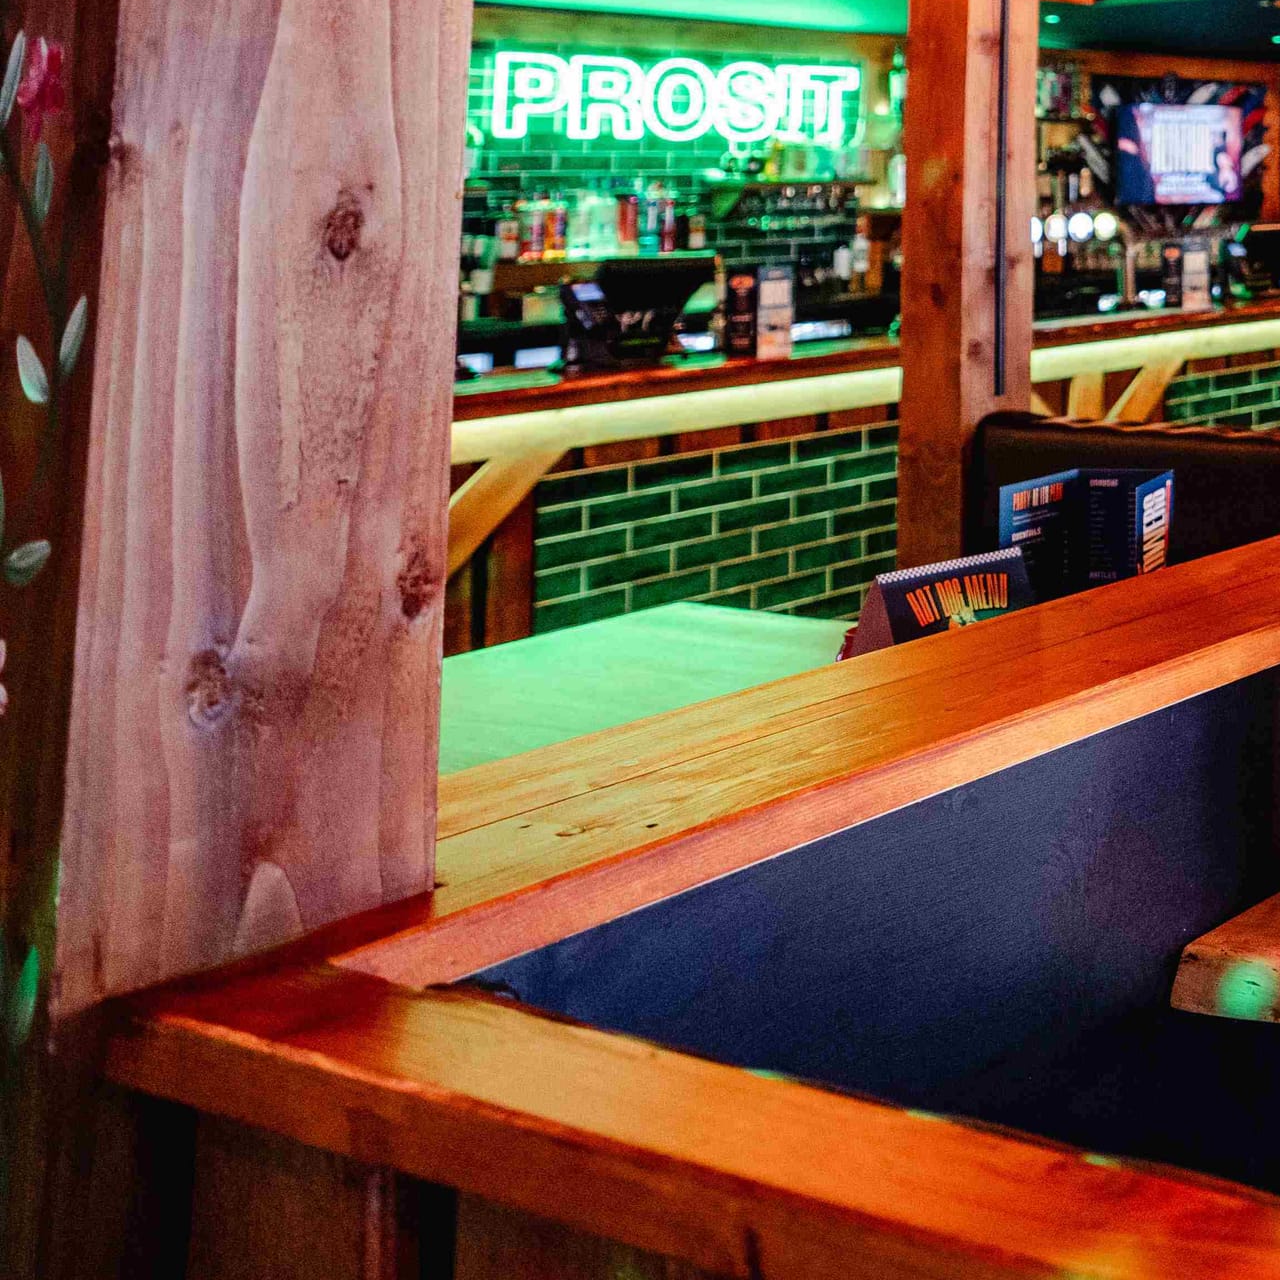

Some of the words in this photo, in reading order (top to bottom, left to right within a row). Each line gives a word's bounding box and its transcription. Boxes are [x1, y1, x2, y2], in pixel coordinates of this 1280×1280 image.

[490, 50, 861, 143] PROSIT
[906, 585, 940, 627] HOT
[935, 578, 968, 618] DOG
[963, 573, 1008, 611] MENU
